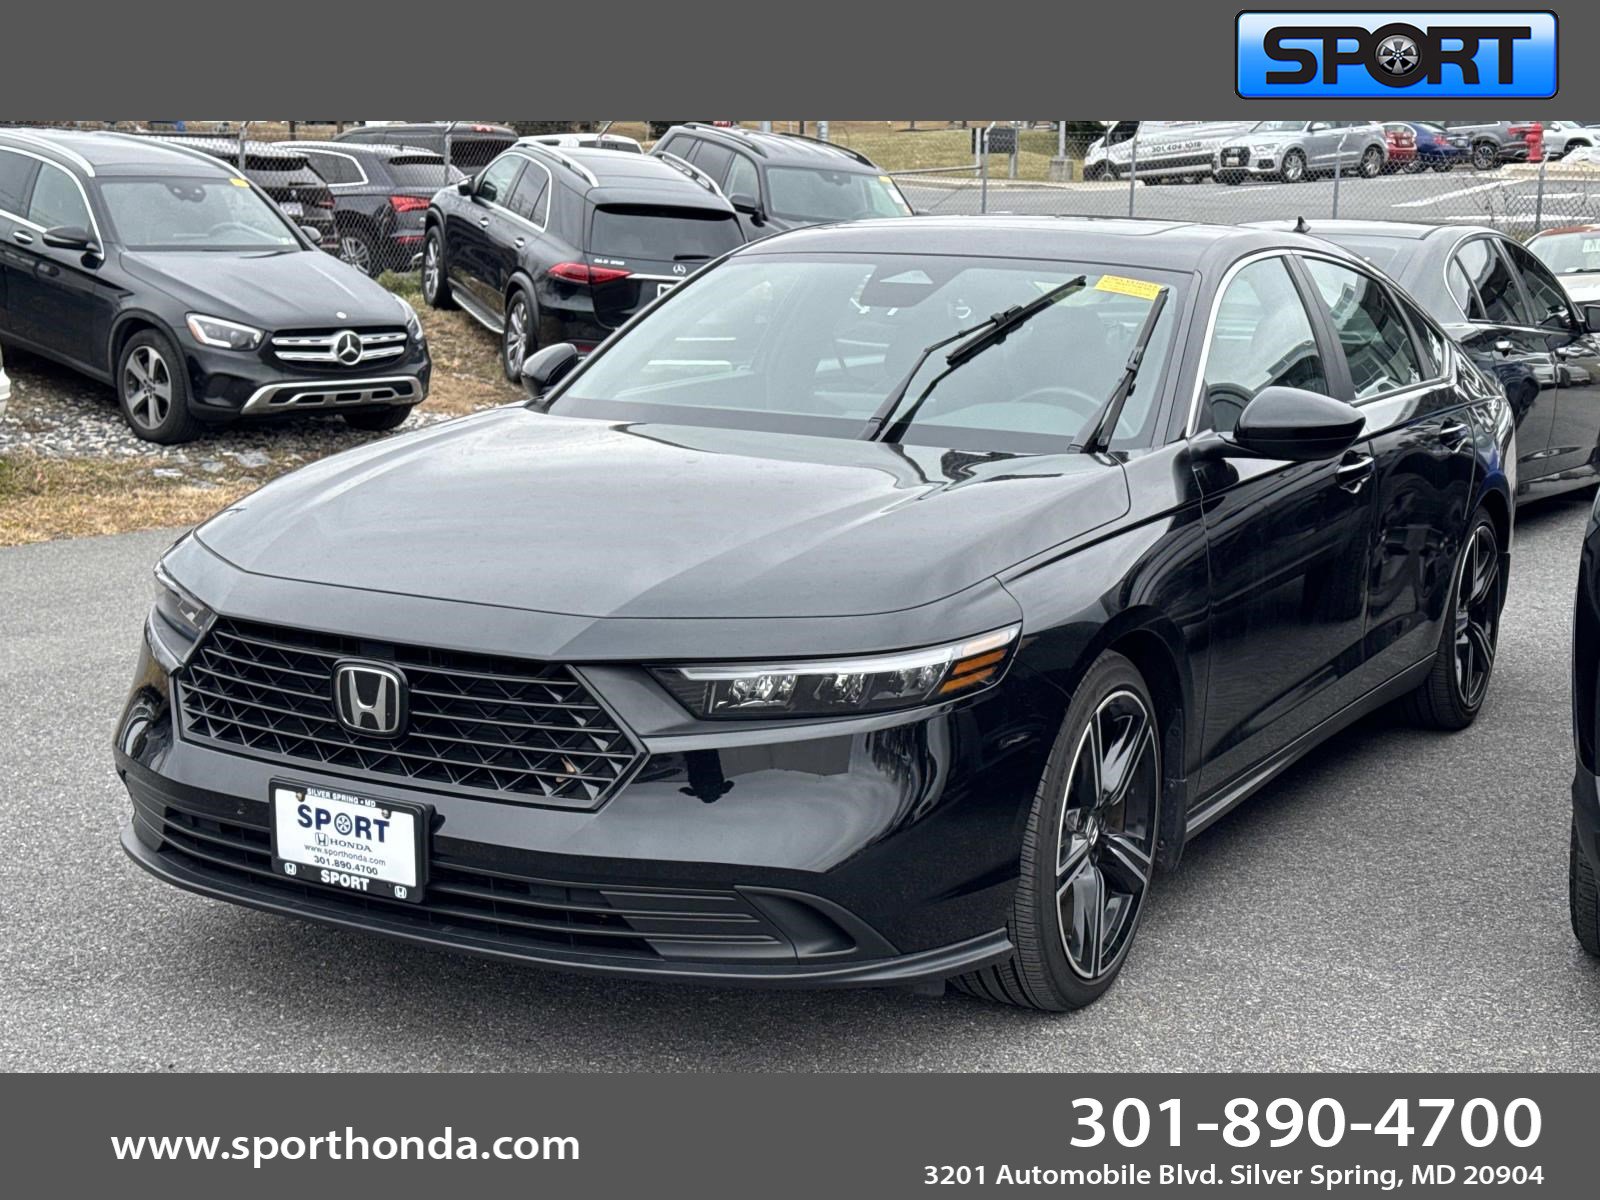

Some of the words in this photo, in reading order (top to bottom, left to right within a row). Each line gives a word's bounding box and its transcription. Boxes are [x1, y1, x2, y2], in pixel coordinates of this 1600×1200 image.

[306, 788, 331, 799] SILVER
[332, 792, 359, 805] SPRING
[364, 799, 376, 808] MD
[297, 804, 390, 843] SPORT
[304, 844, 386, 866] www.sporthonda.com
[329, 838, 373, 853] HONDA
[314, 855, 379, 876] 301.890.4700
[320, 869, 370, 891] SPORT
